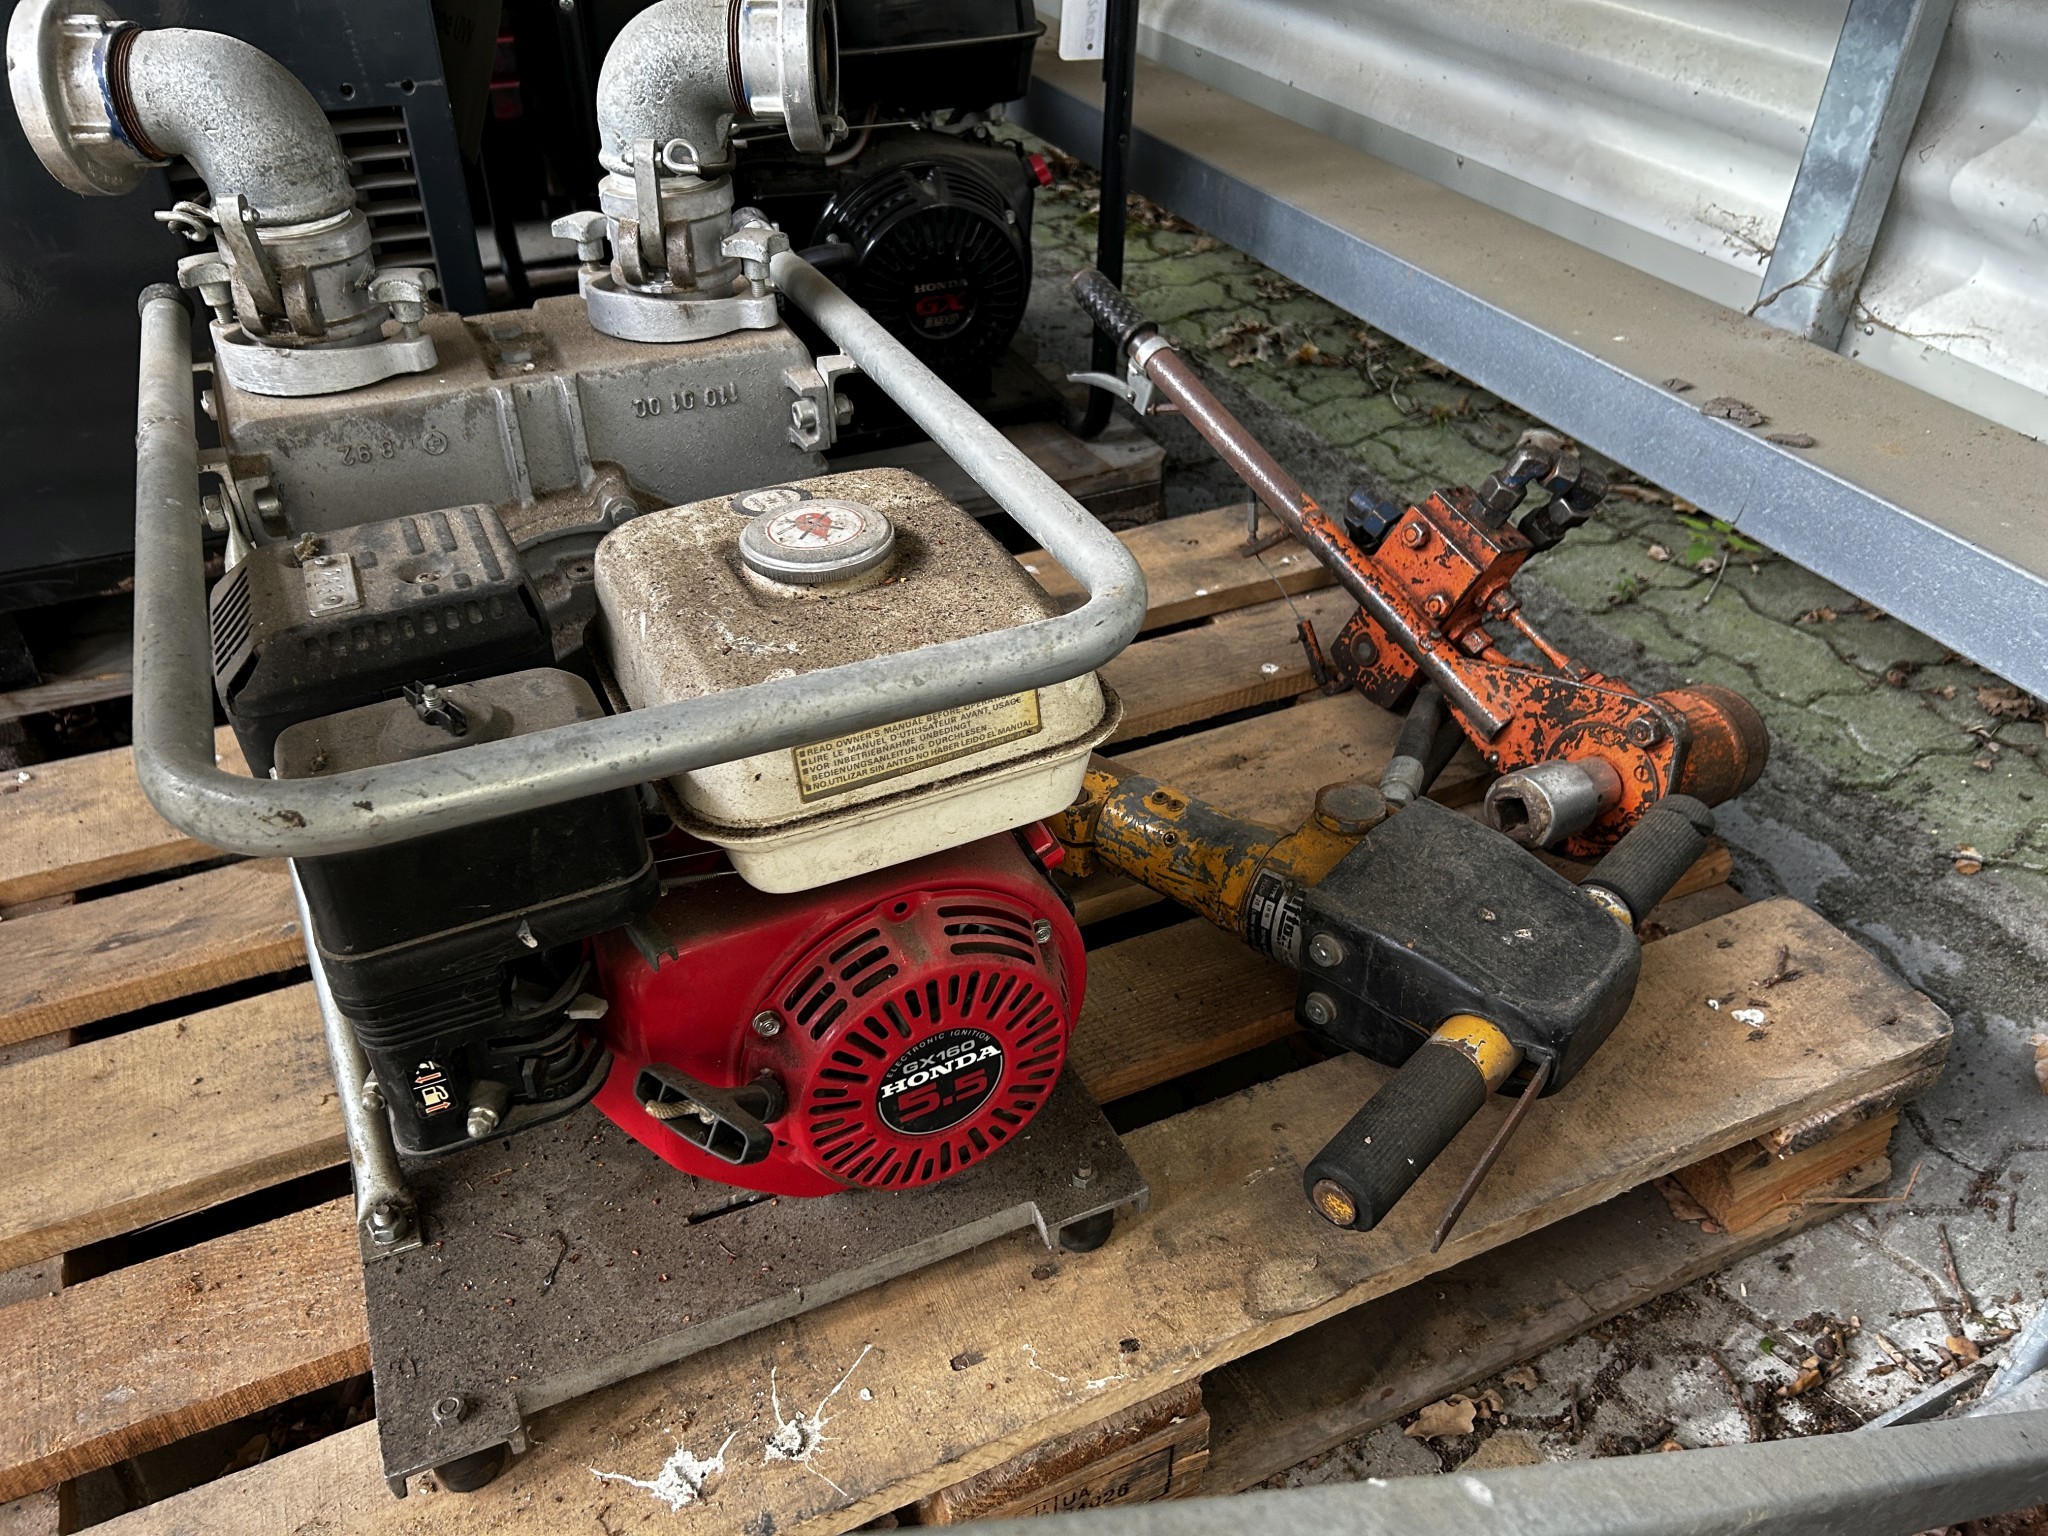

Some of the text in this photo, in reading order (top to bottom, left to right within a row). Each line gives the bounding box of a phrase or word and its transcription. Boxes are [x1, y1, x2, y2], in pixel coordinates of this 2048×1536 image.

[914, 278, 968, 293] HONDA
[916, 291, 965, 316] GX
[807, 694, 1013, 756] READ OWNER'S MANUAL BEFORE OPERA
[808, 753, 829, 765] LIRE
[832, 750, 844, 758] LE
[847, 737, 887, 754] MANUEL
[890, 717, 957, 741] D'UTILISATEUR
[993, 696, 1021, 711] USAGE
[810, 720, 971, 773] VOR INBETRIEBNAHME UNBEDINGT
[869, 764, 885, 774] SIN
[886, 755, 915, 769] ANTES
[916, 751, 929, 760] NO
[931, 741, 960, 756] HABER
[961, 734, 986, 747] LEIDO
[997, 720, 1032, 736] MANUAL
[811, 743, 925, 782] BEDIENUNGSANLEITUNG
[900, 762, 926, 774] HONDA
[1017, 727, 1038, 737] JAPN
[881, 1045, 1001, 1098] HONDA
[886, 1029, 991, 1078] ELECTRONIC IGNITION
[902, 1039, 976, 1075] GX160
[897, 1068, 988, 1123] 5.5
[1063, 1487, 1090, 1506] UA
